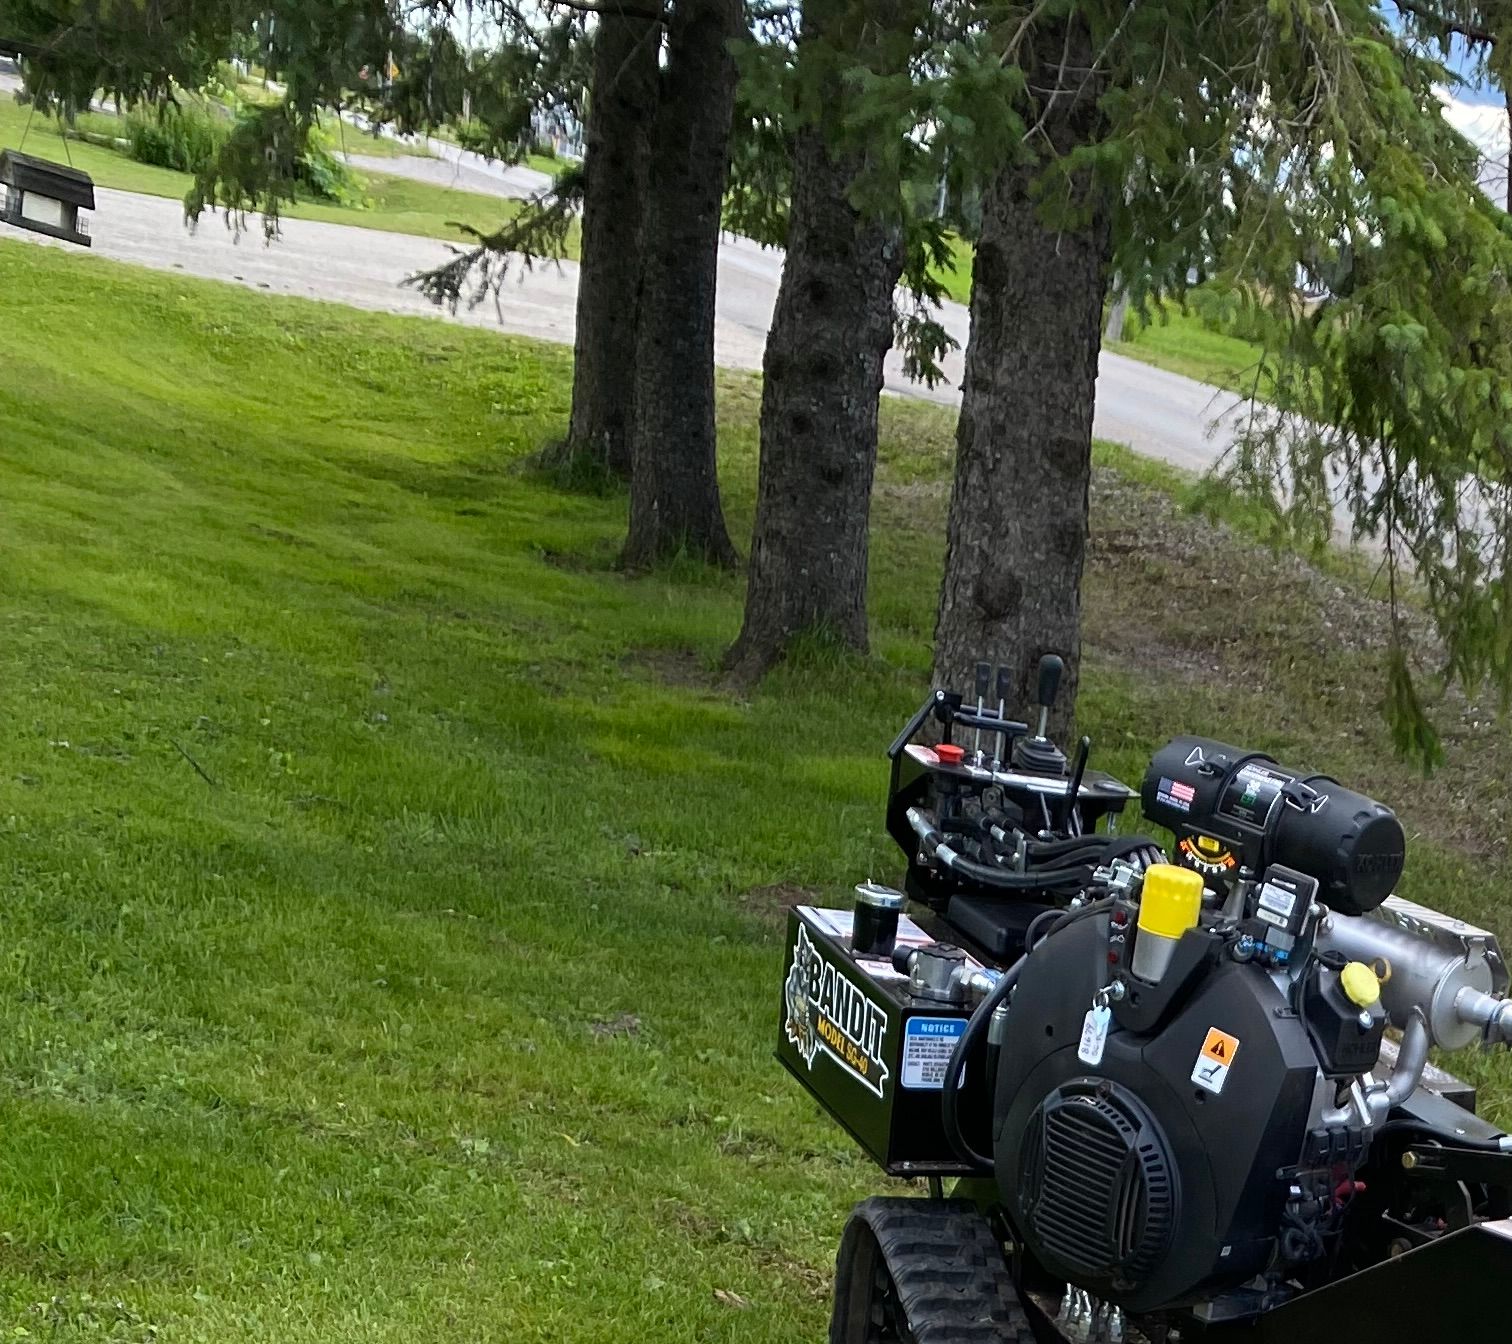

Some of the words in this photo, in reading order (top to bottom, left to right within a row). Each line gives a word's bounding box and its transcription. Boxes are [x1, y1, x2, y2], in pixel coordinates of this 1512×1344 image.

[808, 949, 888, 1061] BANDIT
[920, 1023, 955, 1033] NOTICE
[817, 1015, 845, 1055] MODEL
[846, 1043, 869, 1075] SG-40
